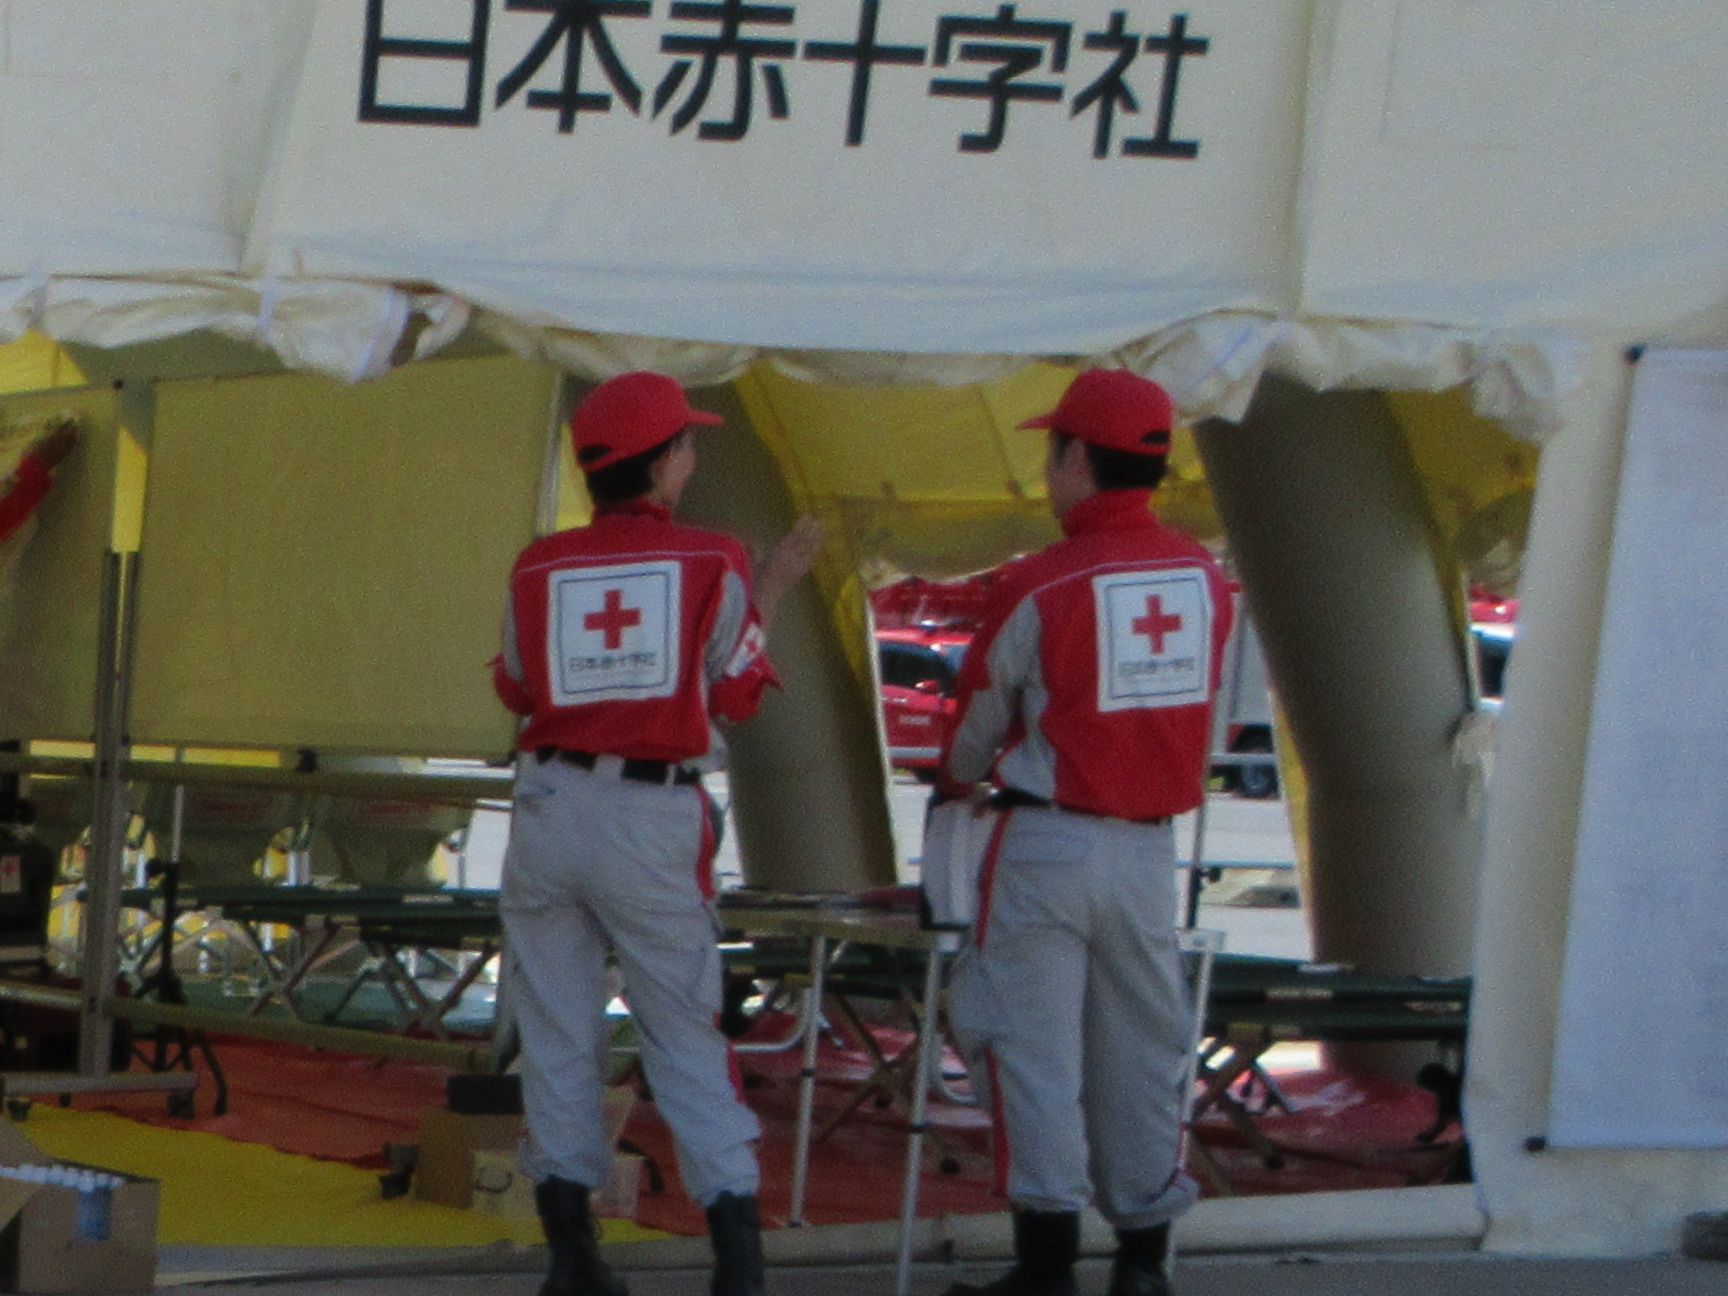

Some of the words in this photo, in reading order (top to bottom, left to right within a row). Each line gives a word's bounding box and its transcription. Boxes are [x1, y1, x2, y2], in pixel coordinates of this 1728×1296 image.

[357, 0, 1209, 160] 日本赤十字社
